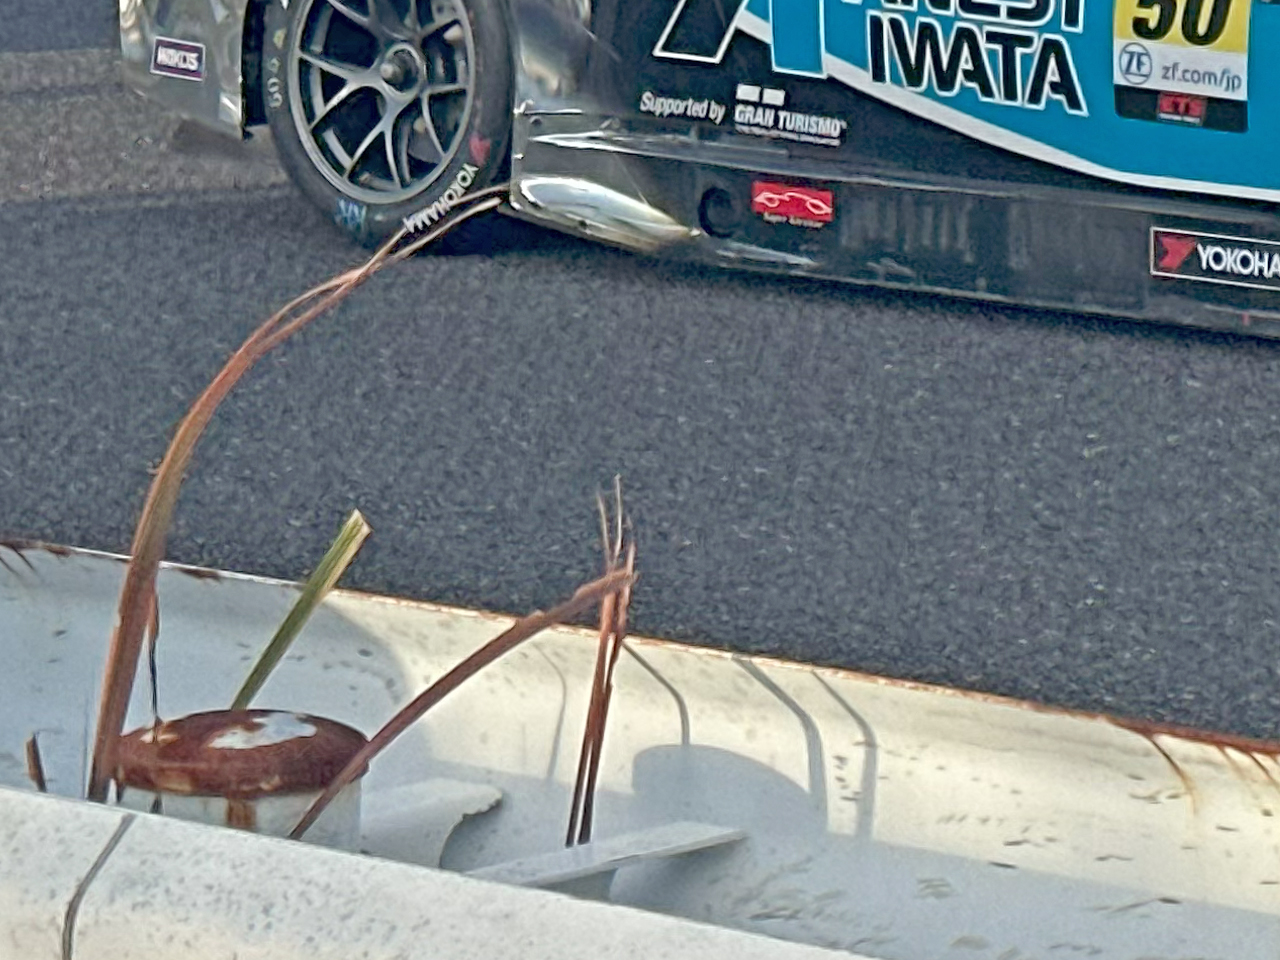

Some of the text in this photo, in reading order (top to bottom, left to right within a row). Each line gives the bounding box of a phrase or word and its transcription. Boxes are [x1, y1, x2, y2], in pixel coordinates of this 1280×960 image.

[866, 10, 1088, 117] IWATA
[1161, 61, 1243, 92] zf.com/jp
[639, 91, 708, 120] Supported
[708, 100, 727, 126] by
[734, 104, 776, 128] GRAN
